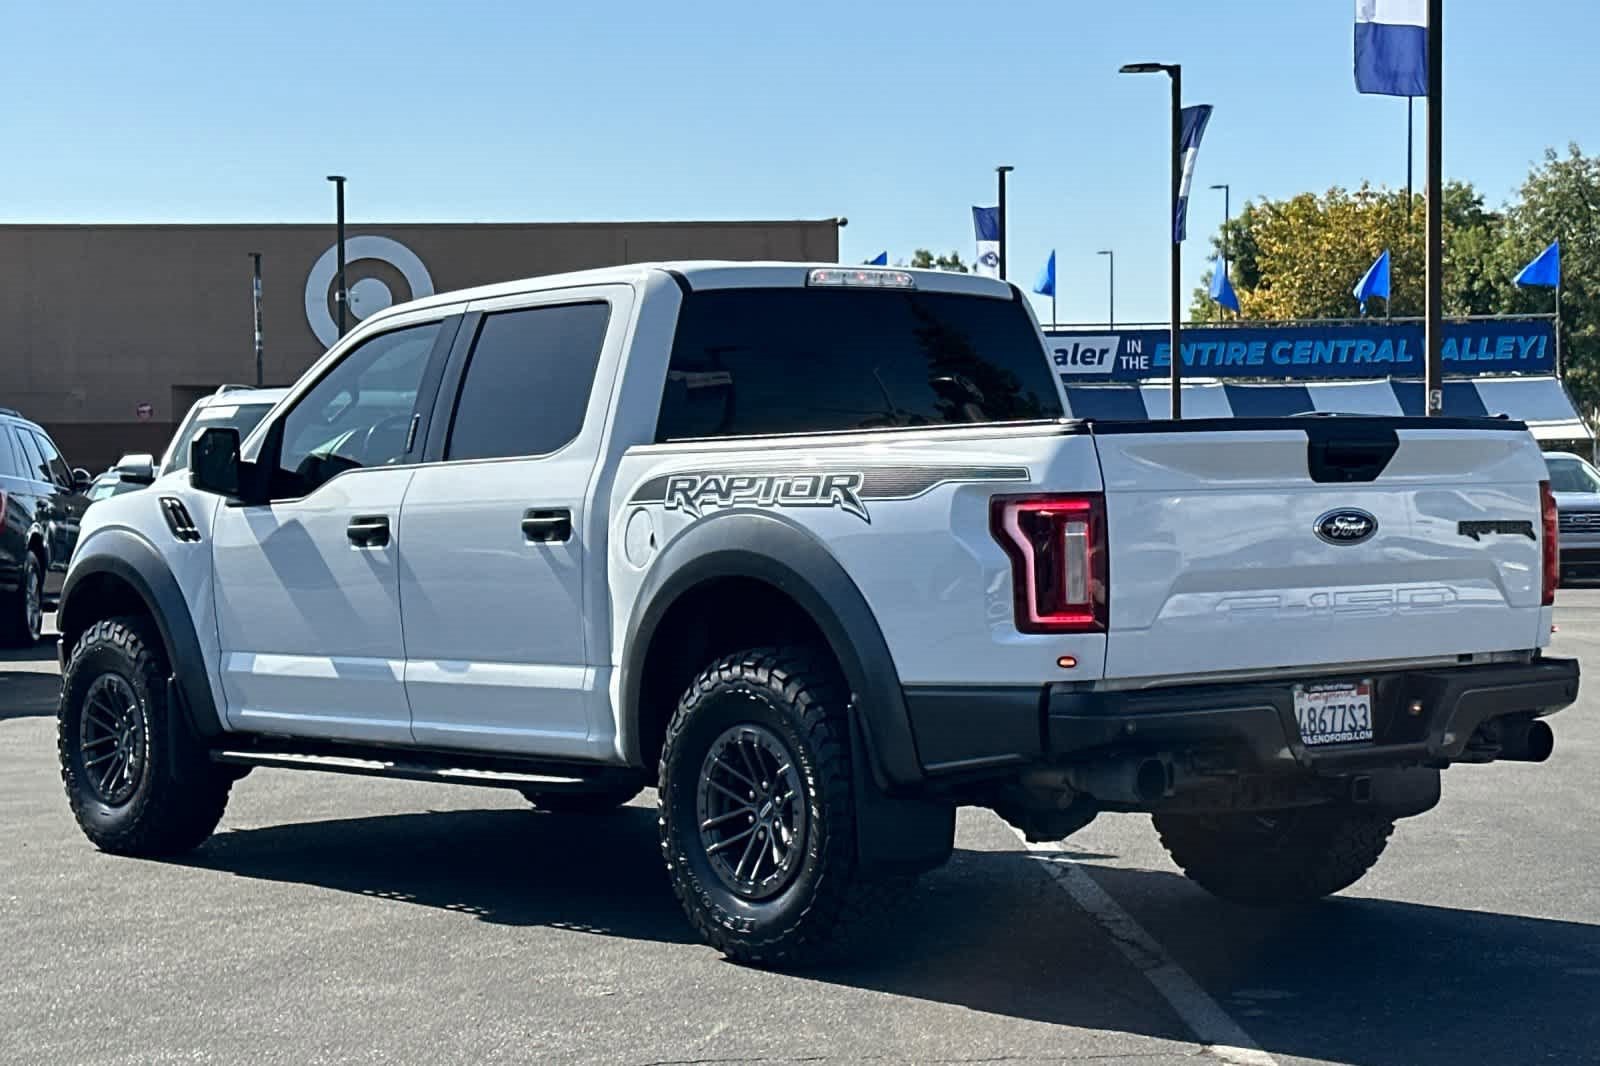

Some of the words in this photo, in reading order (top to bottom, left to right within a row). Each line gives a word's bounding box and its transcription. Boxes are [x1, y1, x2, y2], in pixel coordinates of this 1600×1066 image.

[1126, 339, 1142, 354] IN
[1271, 338, 1413, 365] CENTRAL
[1421, 335, 1547, 361] ALLEY!
[1120, 355, 1149, 370] THE
[664, 472, 870, 524] RAPTOR
[1325, 515, 1367, 537] Ford
